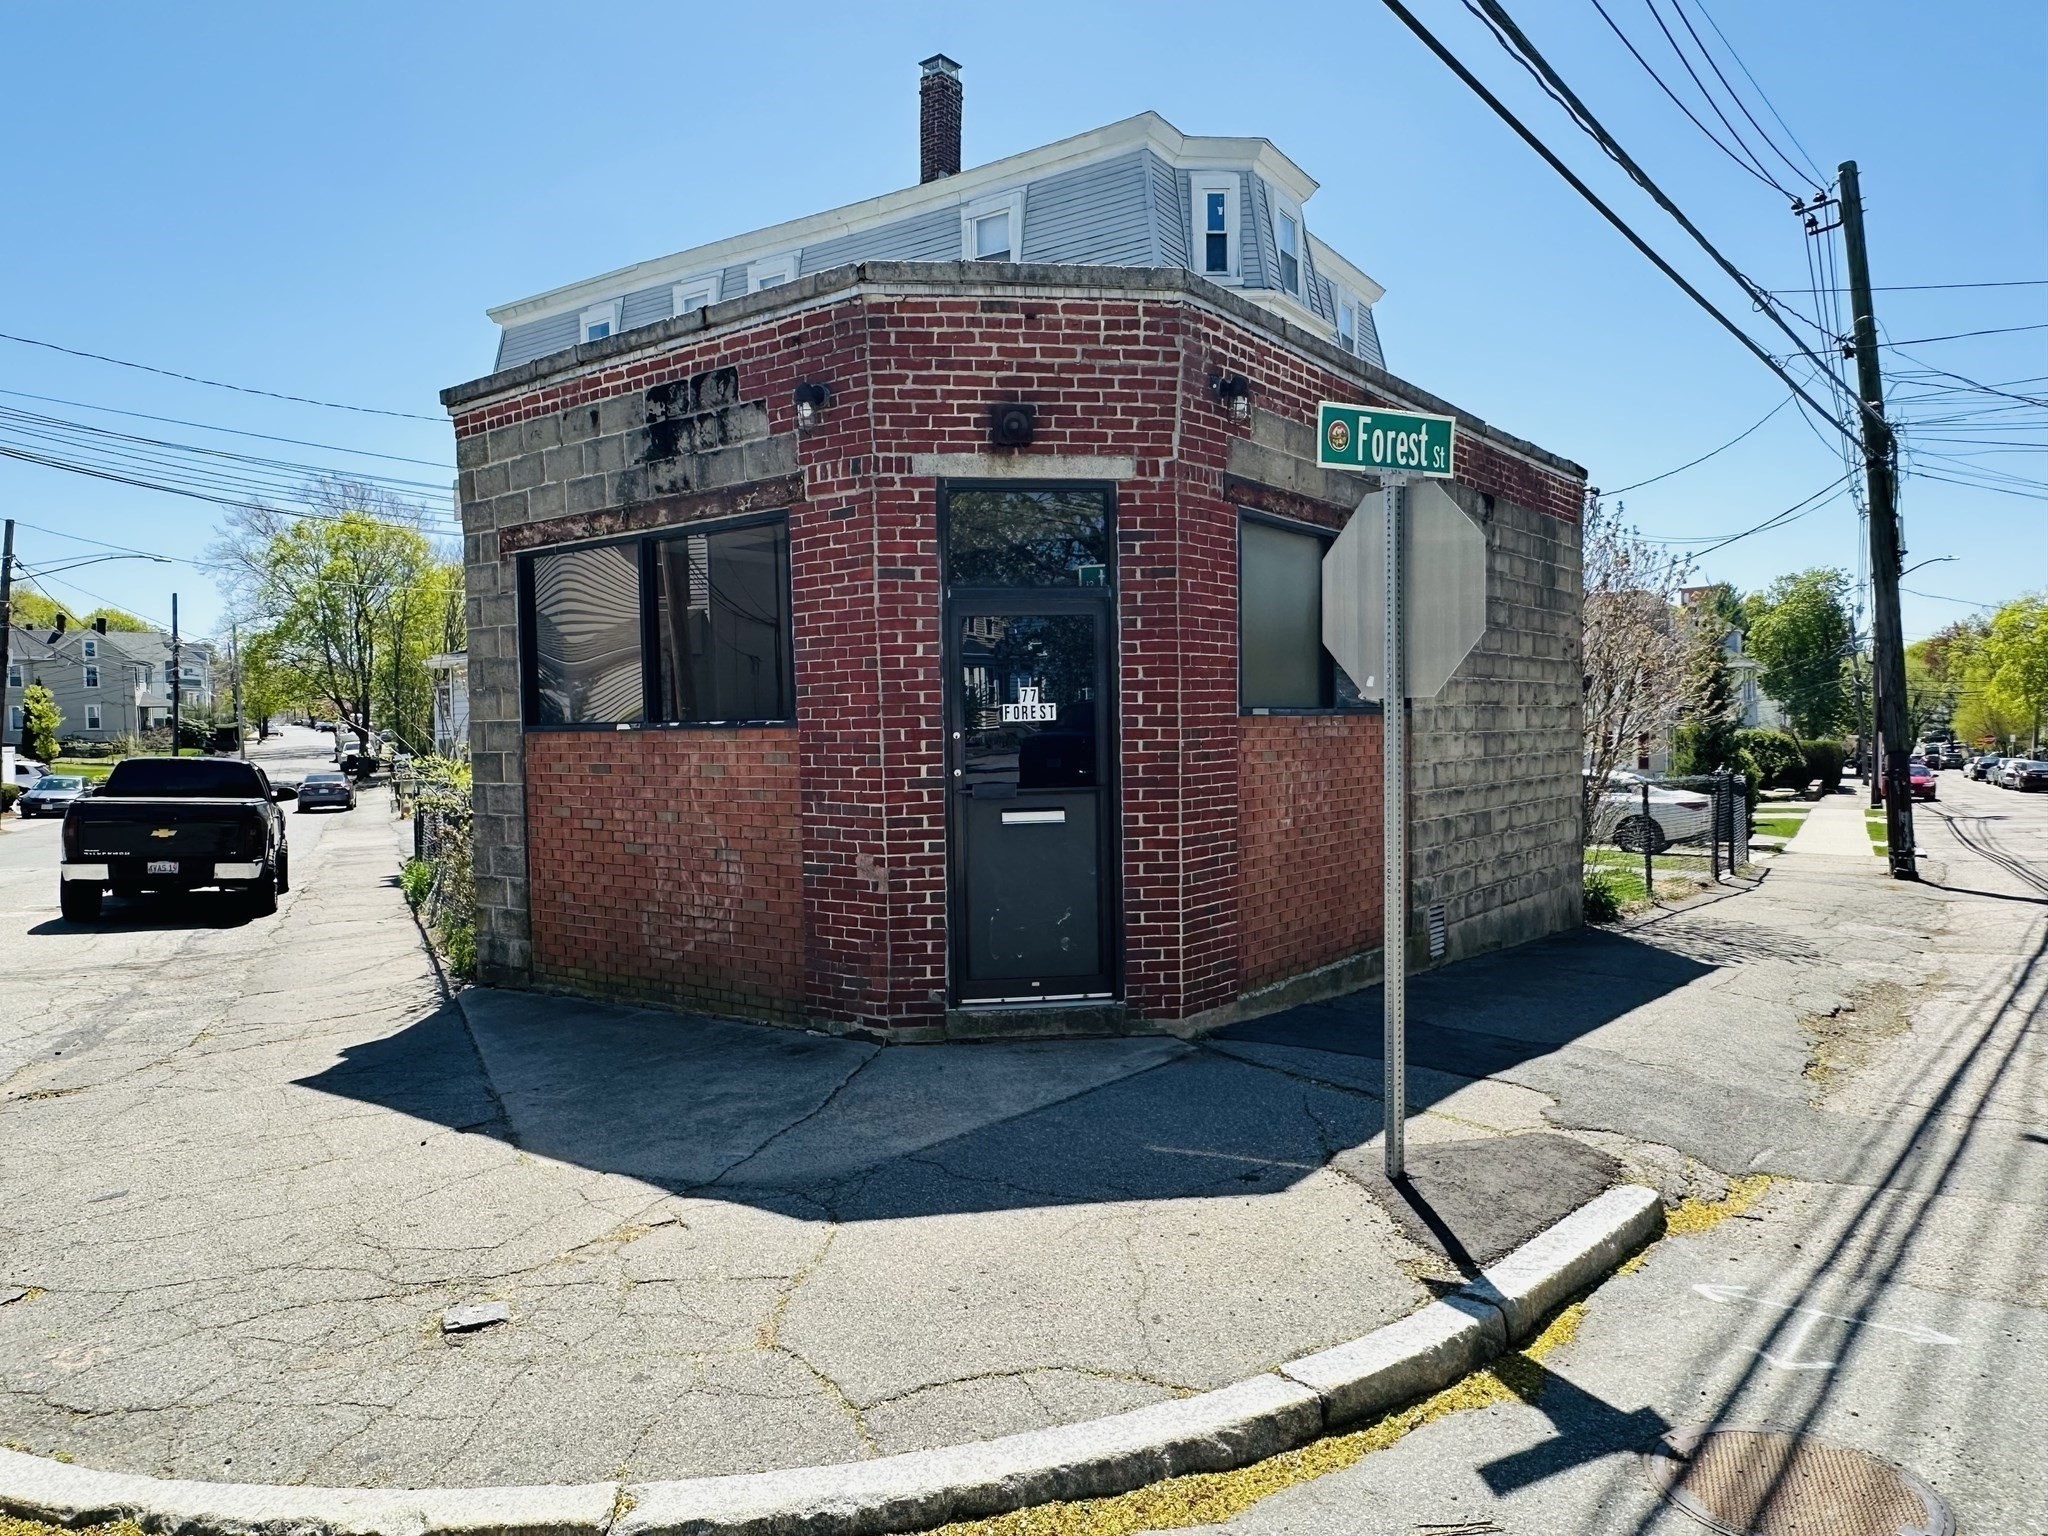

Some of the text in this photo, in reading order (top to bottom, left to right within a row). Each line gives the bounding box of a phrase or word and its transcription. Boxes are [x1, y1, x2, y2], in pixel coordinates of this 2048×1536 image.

[1357, 415, 1445, 469] Forest St
[1021, 689, 1037, 703] 77
[1004, 705, 1055, 720] FOREST
